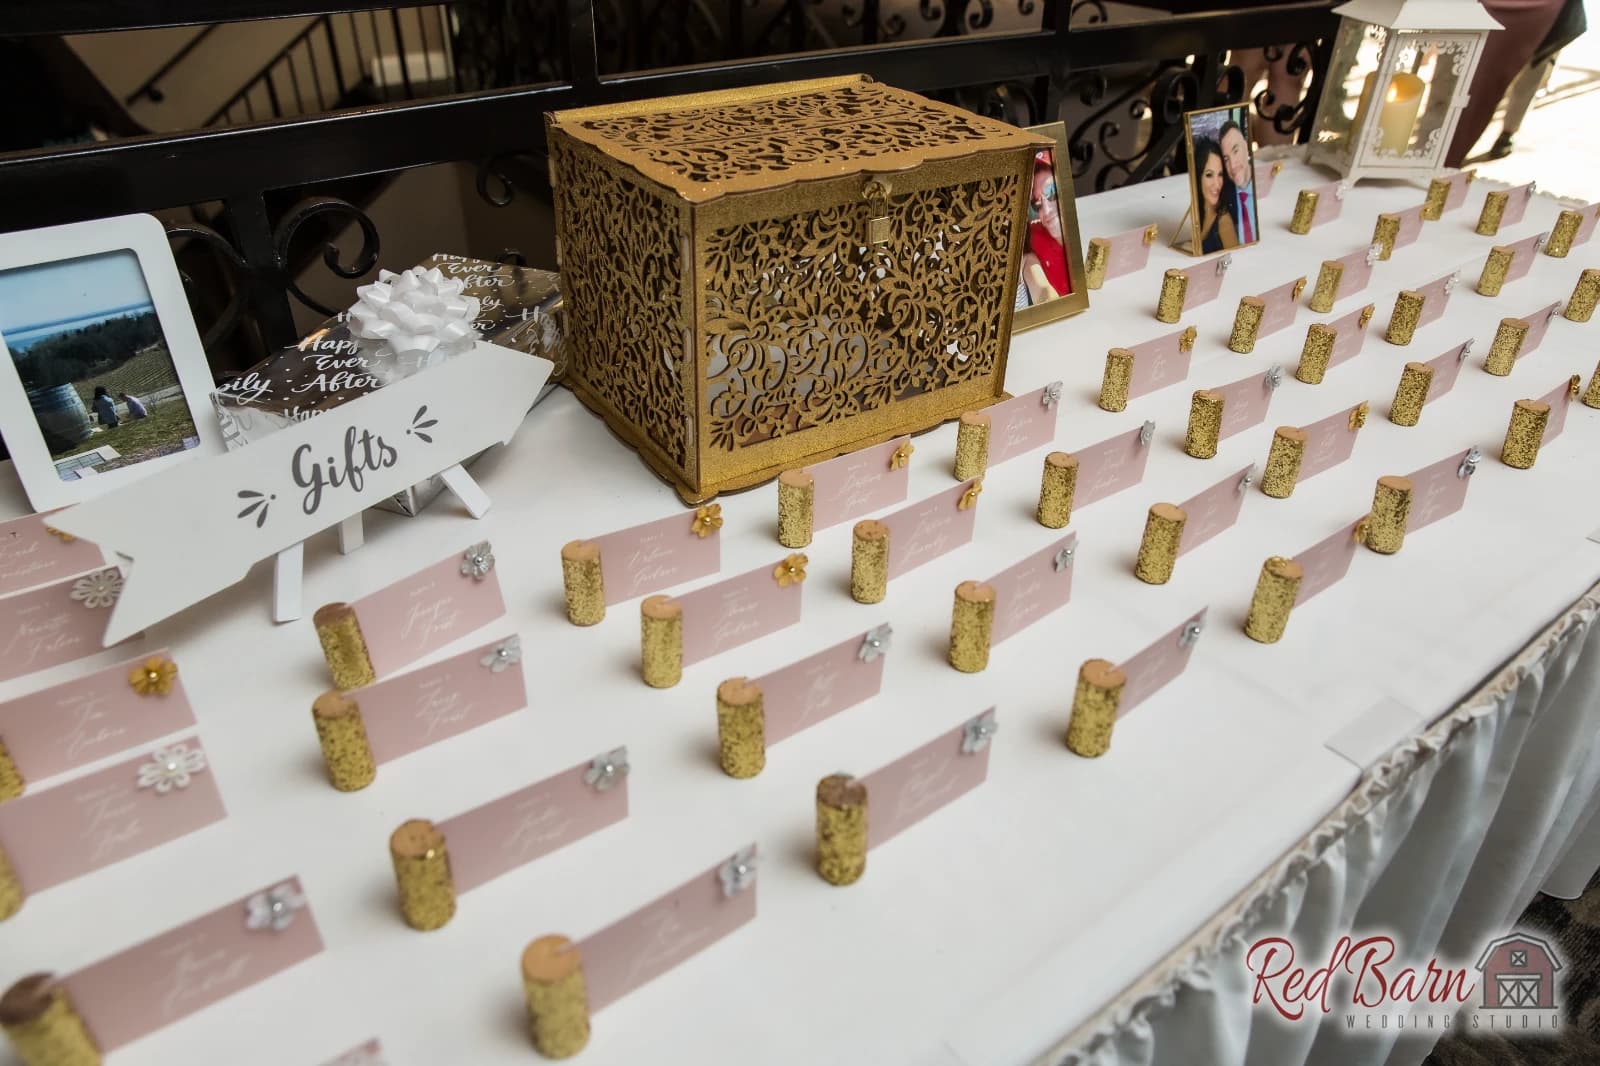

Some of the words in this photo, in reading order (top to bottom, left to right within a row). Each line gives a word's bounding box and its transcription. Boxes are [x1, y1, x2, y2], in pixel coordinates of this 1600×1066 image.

[463, 274, 516, 289] fter
[303, 354, 381, 371] Ever
[291, 371, 391, 393] After
[291, 426, 398, 515] Gifts
